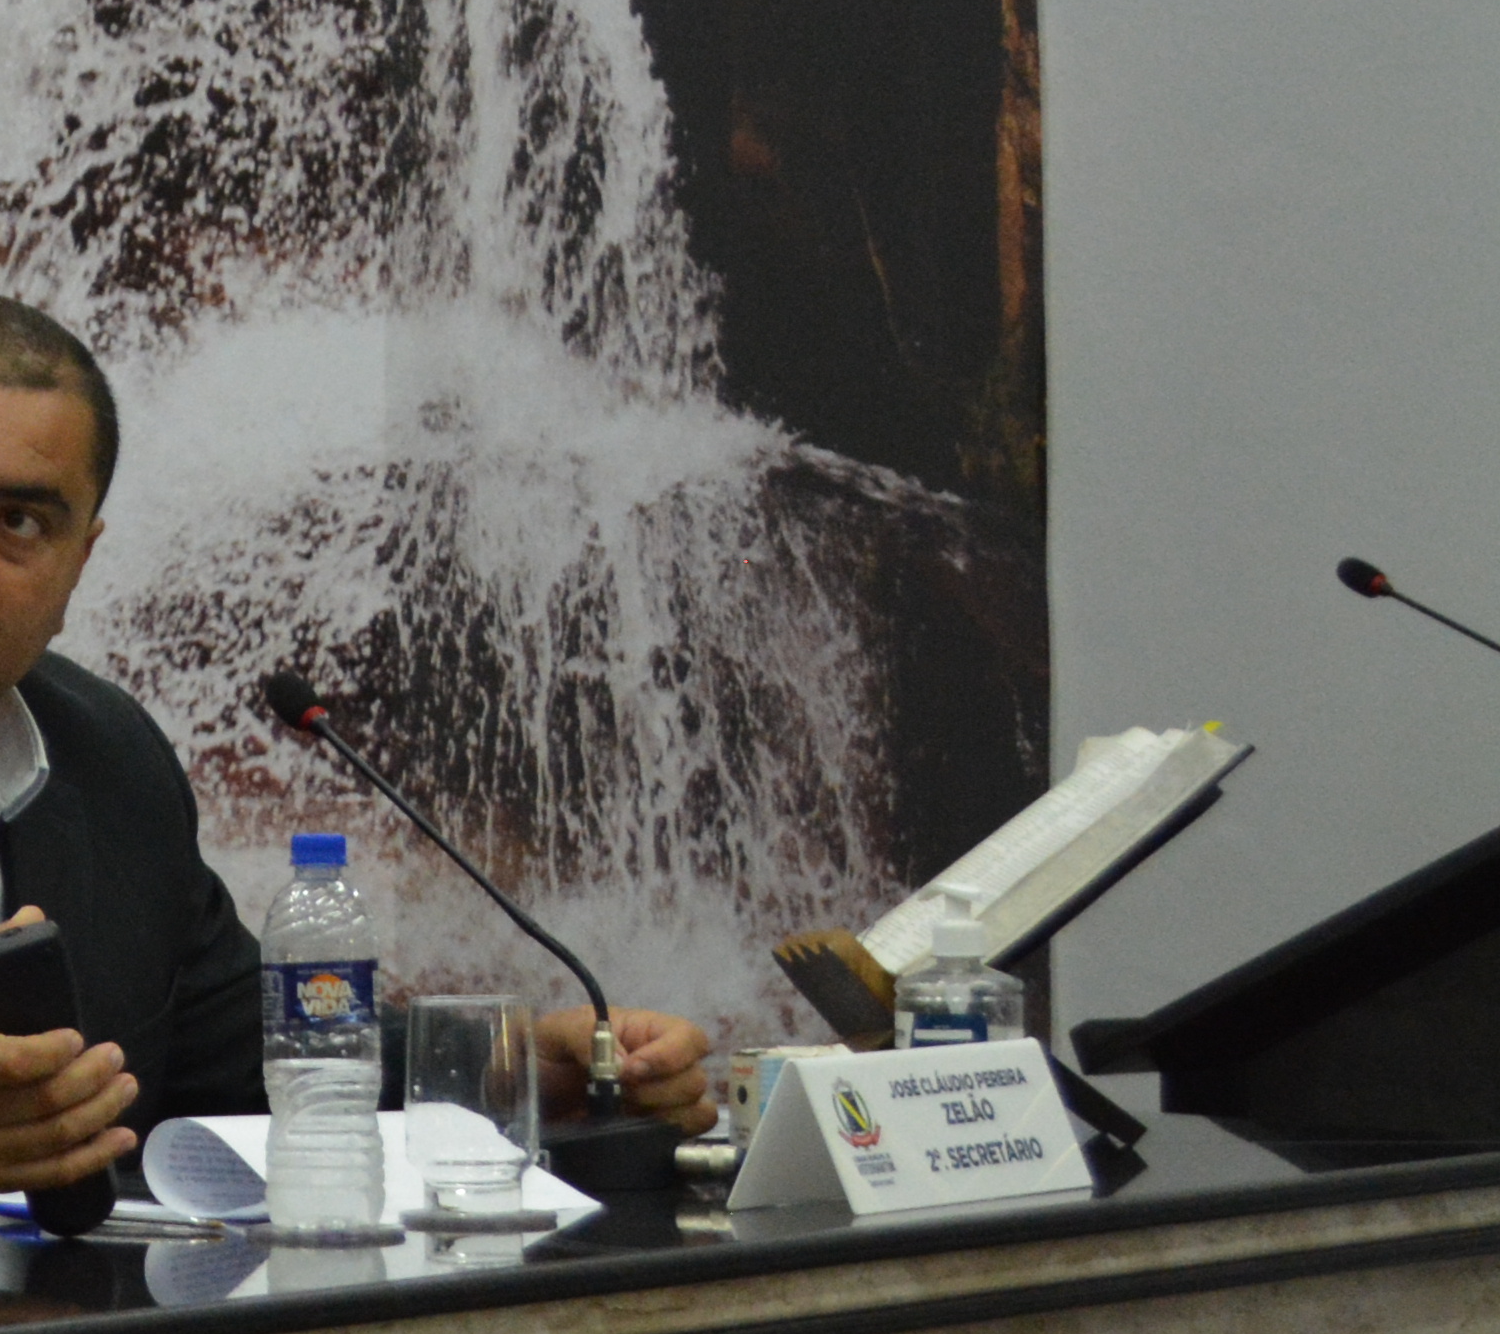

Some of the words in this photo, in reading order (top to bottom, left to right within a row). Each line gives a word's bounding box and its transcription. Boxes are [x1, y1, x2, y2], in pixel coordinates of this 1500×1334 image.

[297, 979, 354, 999] NOVA
[301, 998, 352, 1017] VIDA
[889, 1074, 921, 1098] JOSÉ
[921, 1070, 974, 1094] CLÁUDIO
[973, 1067, 1027, 1089] PEREIRA
[941, 1092, 995, 1125] ZELÃO
[947, 1133, 1043, 1169] SECRETÁRIO
